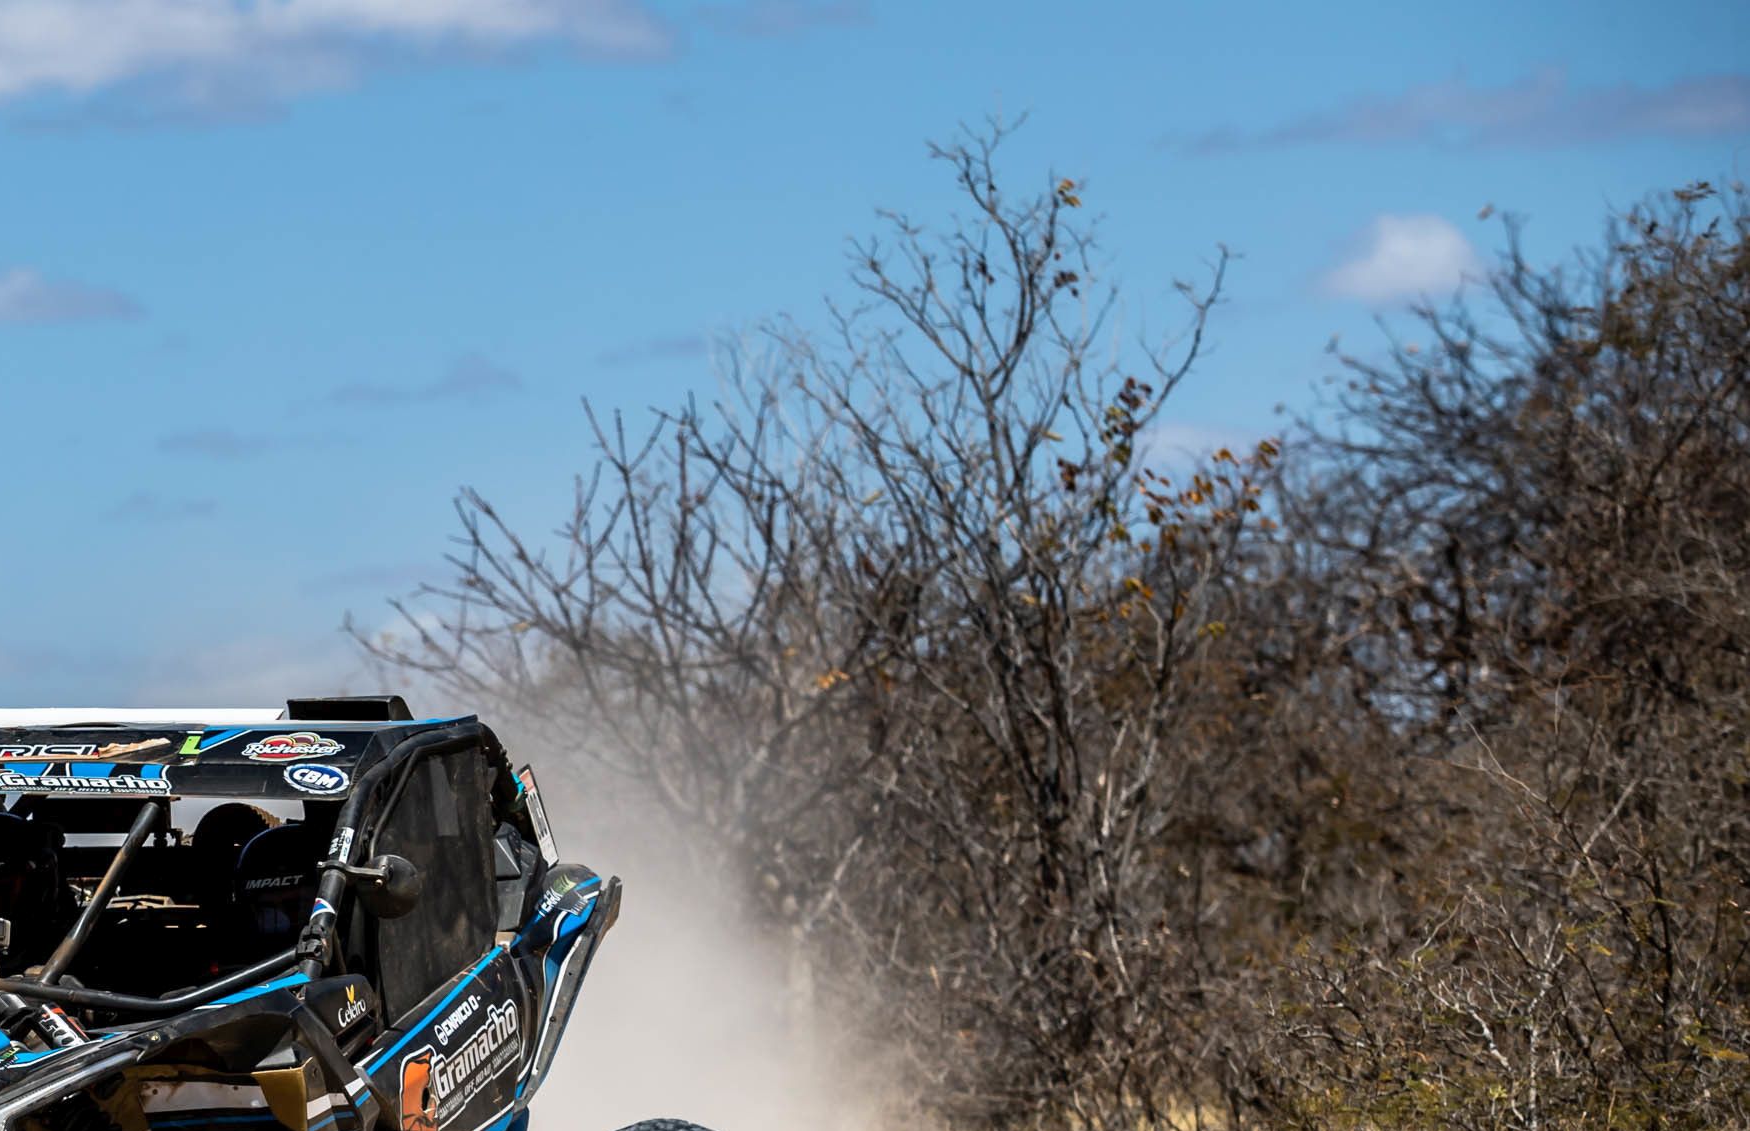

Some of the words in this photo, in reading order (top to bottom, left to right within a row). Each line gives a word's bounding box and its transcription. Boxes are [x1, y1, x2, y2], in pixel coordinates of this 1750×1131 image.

[243, 743, 345, 756] Richester
[1, 774, 168, 789] Gramacho
[292, 768, 340, 789] CBM
[245, 875, 304, 889] IMPACT
[440, 1000, 473, 1037] ENRICO
[434, 1005, 517, 1099] Gramacho
